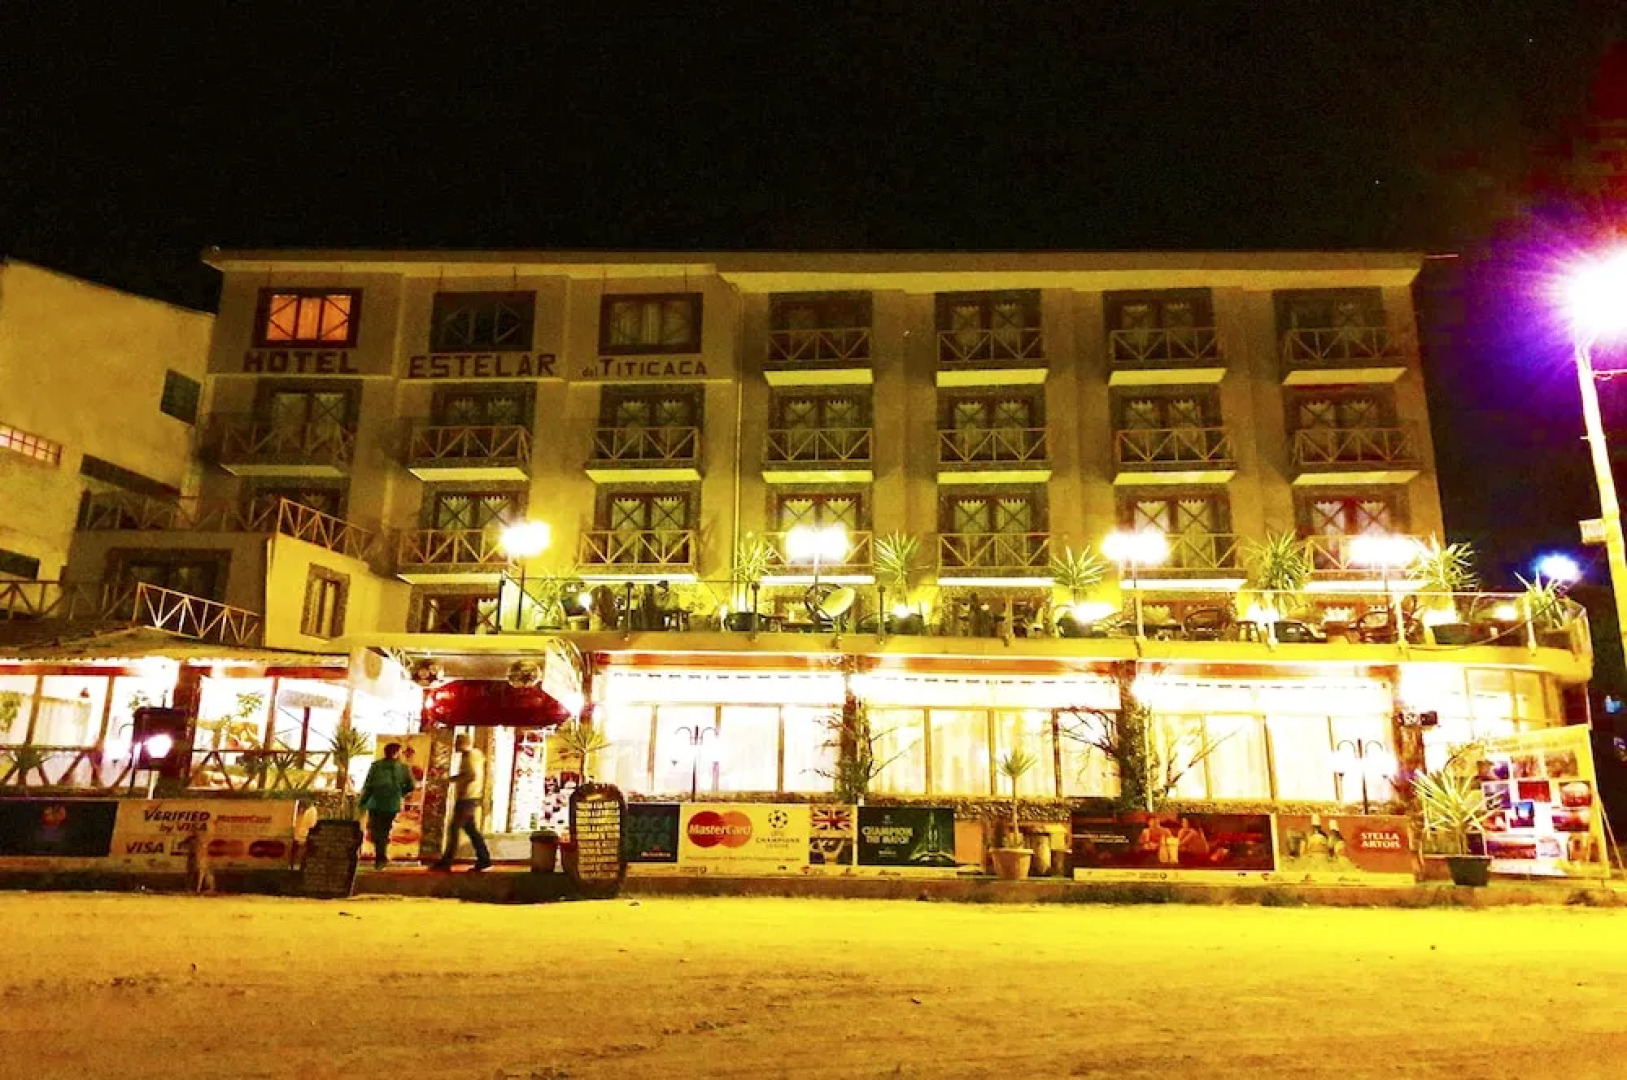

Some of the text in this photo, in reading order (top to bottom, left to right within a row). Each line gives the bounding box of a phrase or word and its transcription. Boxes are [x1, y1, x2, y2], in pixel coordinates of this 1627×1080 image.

[243, 350, 708, 378] HOTEL ESTELAR del TITICACA
[144, 805, 211, 821] VERIFIED
[159, 823, 174, 833] by
[177, 822, 208, 832] VISA
[689, 824, 751, 835] MasterCard
[1361, 832, 1400, 840] STELLA
[126, 841, 165, 854] VISA
[1361, 840, 1402, 848] ARTOIS
